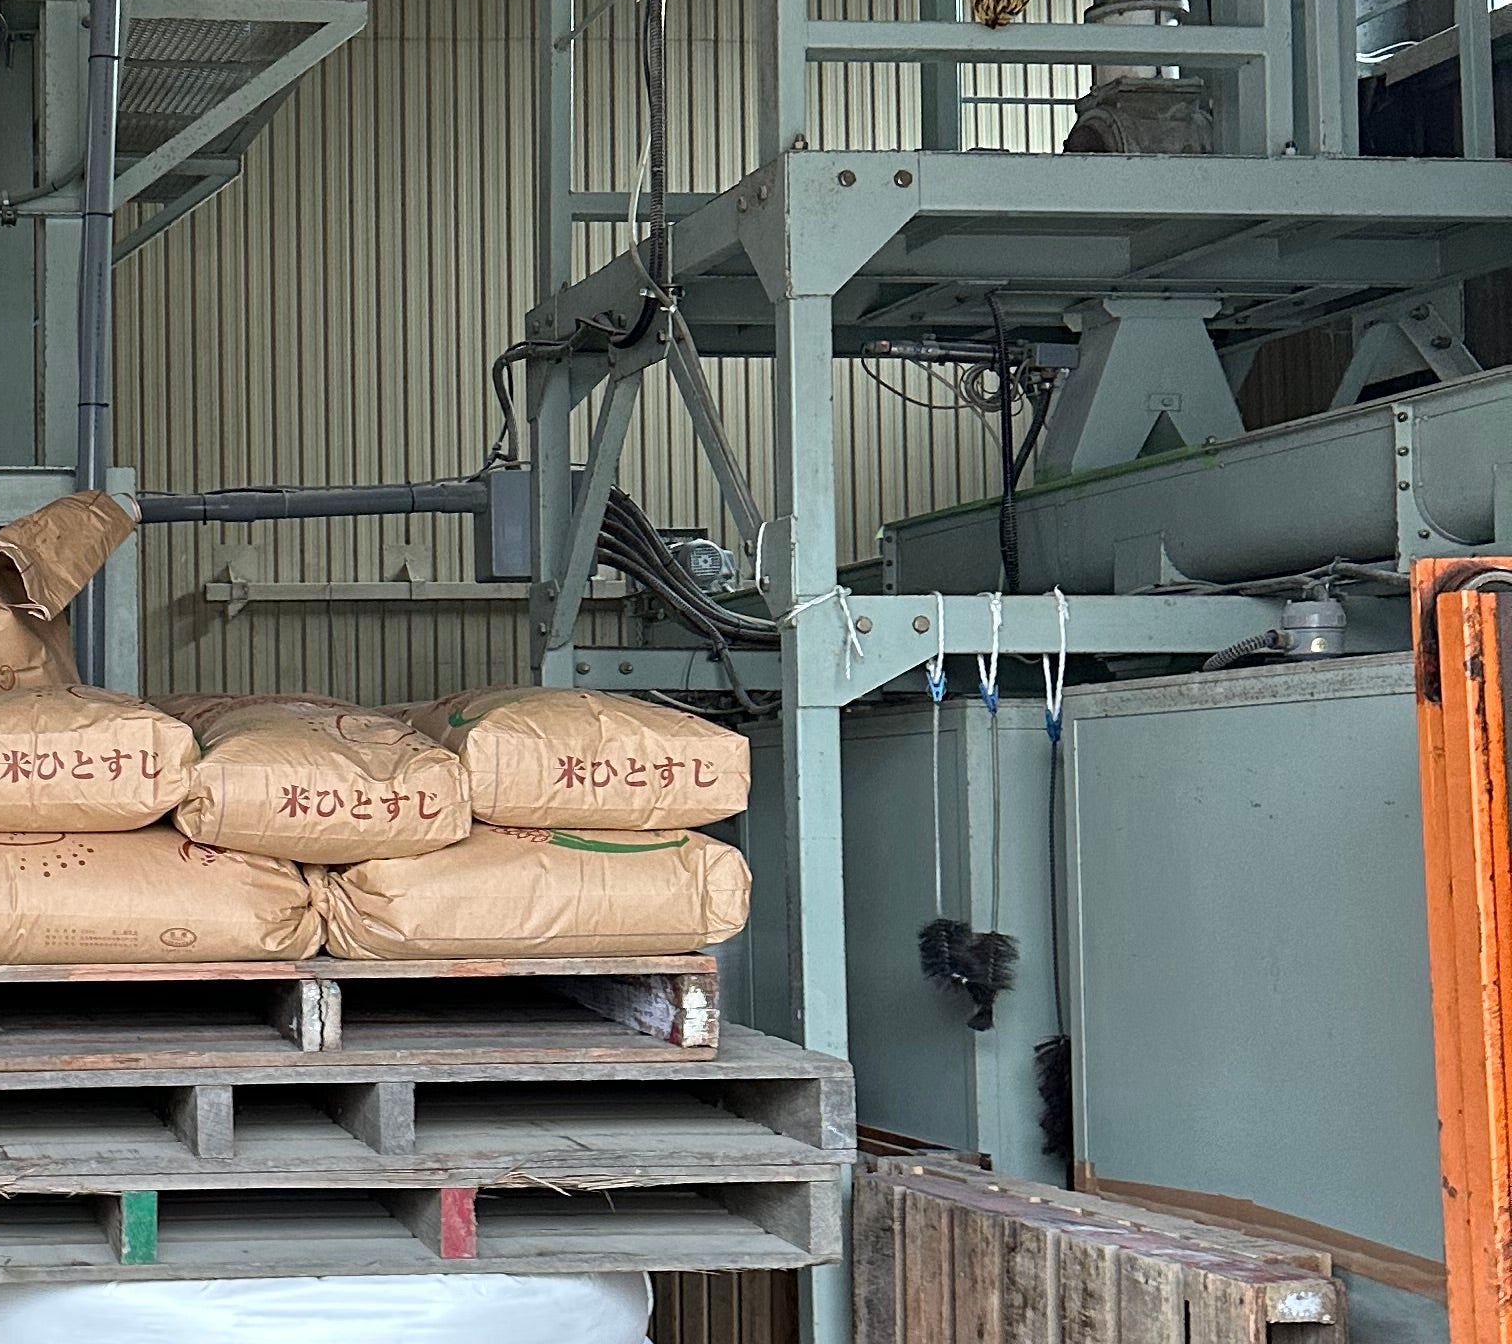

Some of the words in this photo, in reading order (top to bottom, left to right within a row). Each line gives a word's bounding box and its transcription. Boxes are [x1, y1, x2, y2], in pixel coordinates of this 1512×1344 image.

[0, 748, 164, 783] 米ひとすじ
[553, 755, 719, 789] 米ひとすじ
[277, 784, 442, 822] 米ひとすじ
